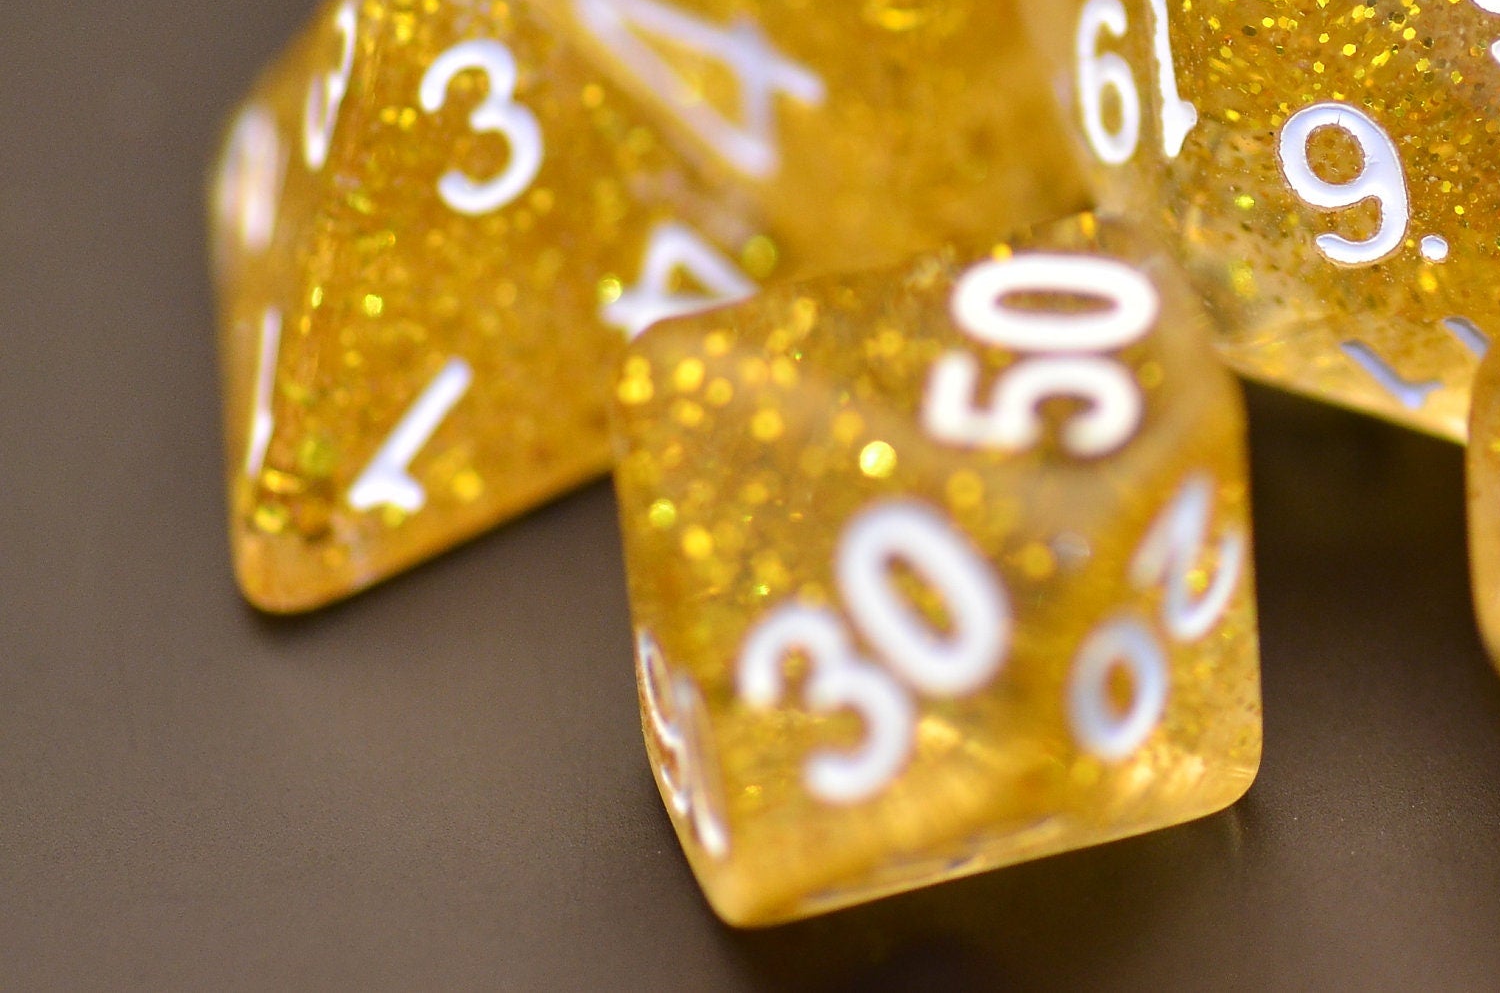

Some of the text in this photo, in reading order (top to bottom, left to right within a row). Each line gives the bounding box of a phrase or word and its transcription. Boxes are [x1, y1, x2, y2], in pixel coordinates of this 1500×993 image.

[420, 38, 544, 214] 3
[602, 220, 763, 343] 4
[922, 251, 1160, 459] 50
[347, 357, 472, 512] 1
[735, 495, 1010, 806] 30
[1067, 471, 1247, 762] 20
